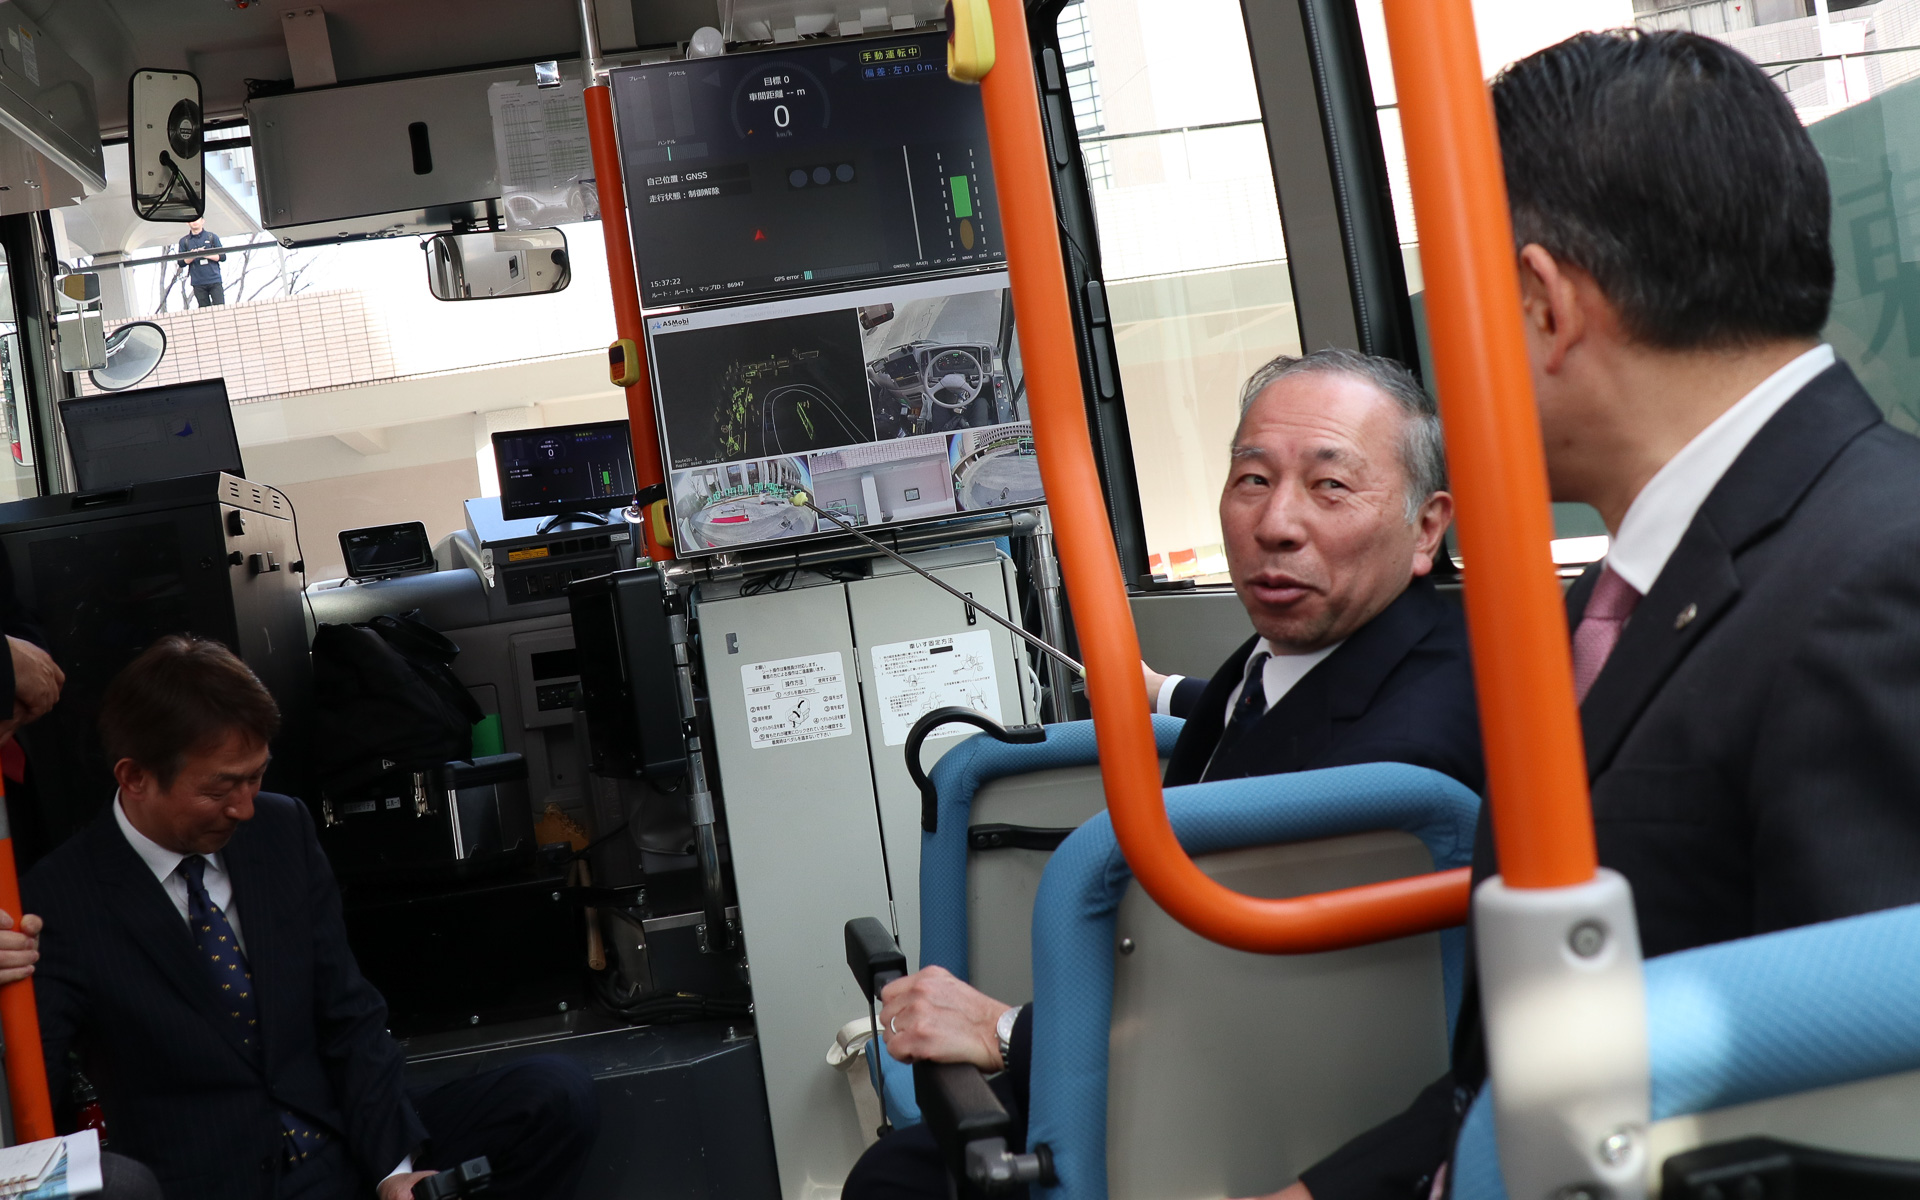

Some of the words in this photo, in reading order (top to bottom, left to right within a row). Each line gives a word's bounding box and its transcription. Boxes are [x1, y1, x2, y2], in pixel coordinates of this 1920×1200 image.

[862, 47, 918, 62] 手動運転中
[763, 76, 782, 87] 目標
[783, 75, 790, 84] 0
[749, 89, 784, 102] 車間距離
[773, 104, 790, 128] 0
[650, 278, 681, 288] 15:37:22
[773, 275, 786, 283] GPS
[727, 280, 745, 289] 86947
[662, 317, 689, 327] ASMobi
[548, 448, 554, 458] 0
[909, 637, 954, 649] 車いす固定方法
[784, 679, 804, 688] 操作方法
